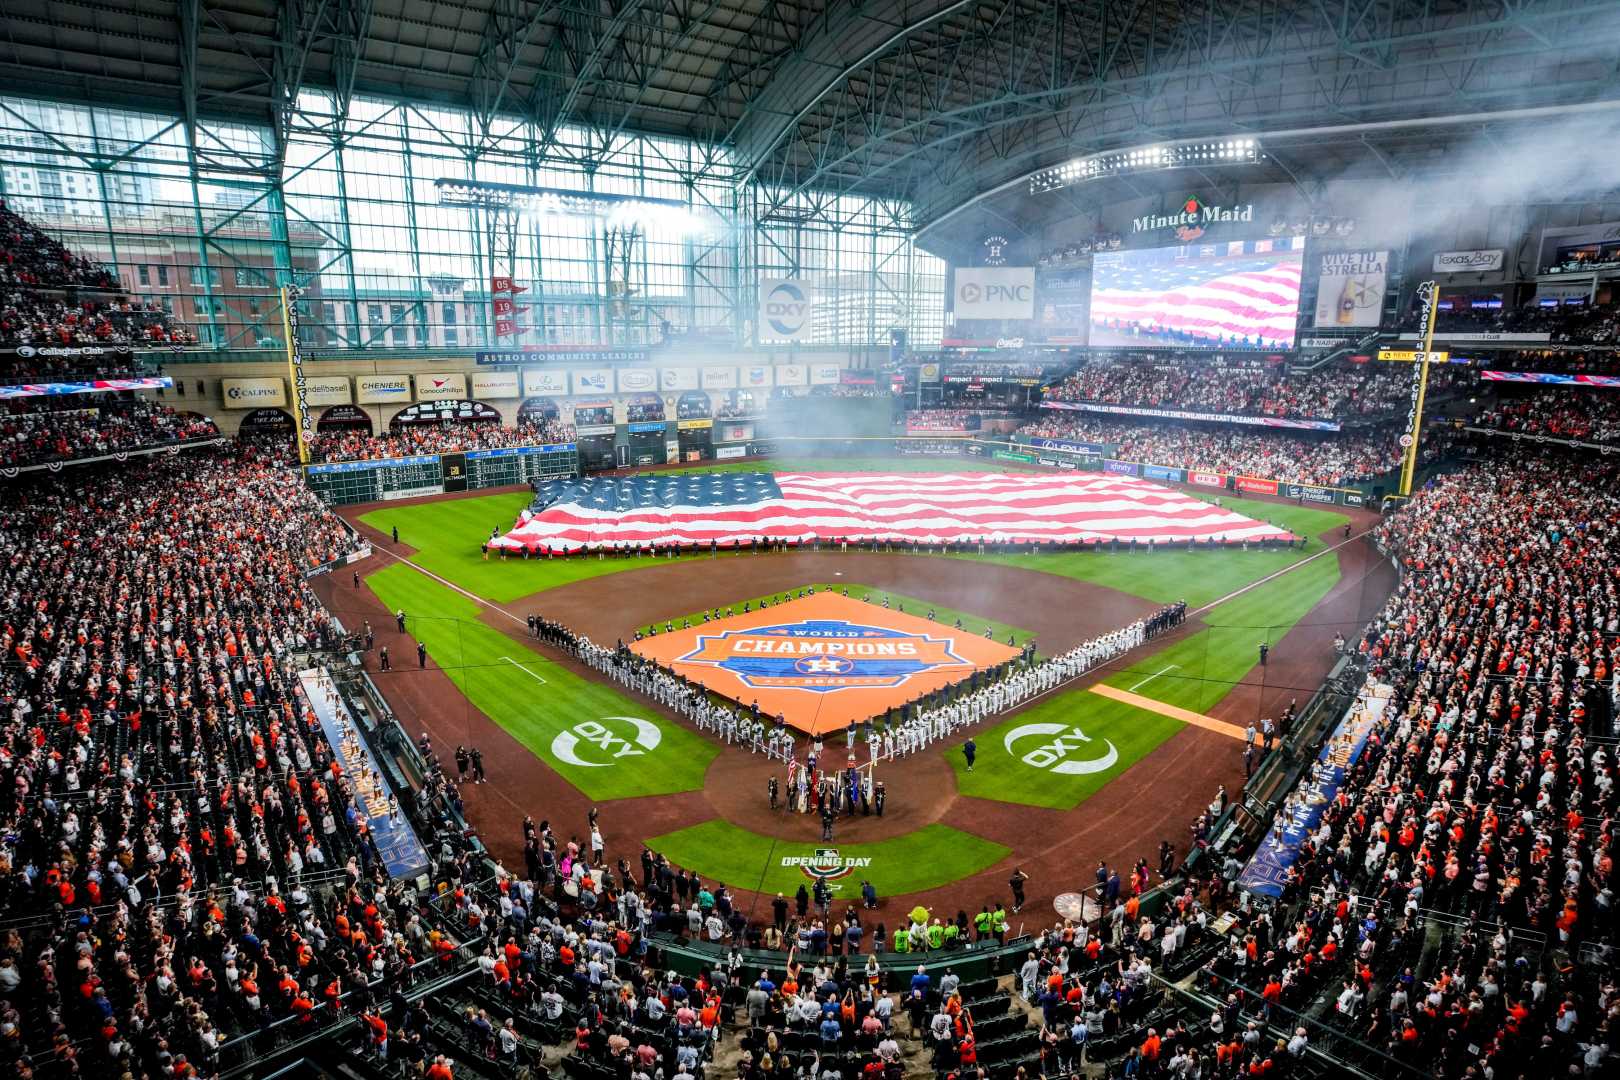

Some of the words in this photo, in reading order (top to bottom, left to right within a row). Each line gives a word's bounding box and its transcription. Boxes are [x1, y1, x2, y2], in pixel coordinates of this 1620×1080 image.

[1132, 210, 1198, 233] Minute
[1202, 205, 1253, 223] Maid
[991, 246, 1001, 257] H
[1323, 253, 1353, 265] VIVE
[1359, 251, 1377, 263] TU
[1438, 254, 1470, 265] Texas
[1470, 251, 1499, 267] Bay
[1320, 263, 1383, 276] ESTRELLA
[496, 280, 509, 289] 05
[985, 285, 1031, 302] PNC
[499, 303, 510, 311] 19
[766, 303, 807, 316] OXY
[1420, 305, 1431, 339] ROOT
[289, 306, 302, 364] CHIKIN
[38, 346, 81, 357] Gallagher
[82, 346, 104, 355] Club
[1416, 342, 1424, 351] 4
[483, 353, 527, 362] ASTROS
[531, 352, 598, 361] COMMUNITY
[601, 352, 645, 360] LEADERS
[1413, 353, 1425, 380] THA
[361, 382, 406, 390] CHENIERE
[948, 376, 972, 384] impact
[979, 376, 1003, 384] impact
[241, 389, 278, 397] CALPINE
[1405, 383, 1420, 433] CHIKIN
[1054, 444, 1090, 454] LEXUS
[1110, 463, 1132, 473] xfinity
[732, 639, 918, 656] CHAMPIONS
[807, 659, 841, 672] H
[573, 720, 645, 758] OXY
[1021, 728, 1093, 768] OXY
[781, 856, 842, 867] OPENING
[845, 857, 872, 867] DAY
